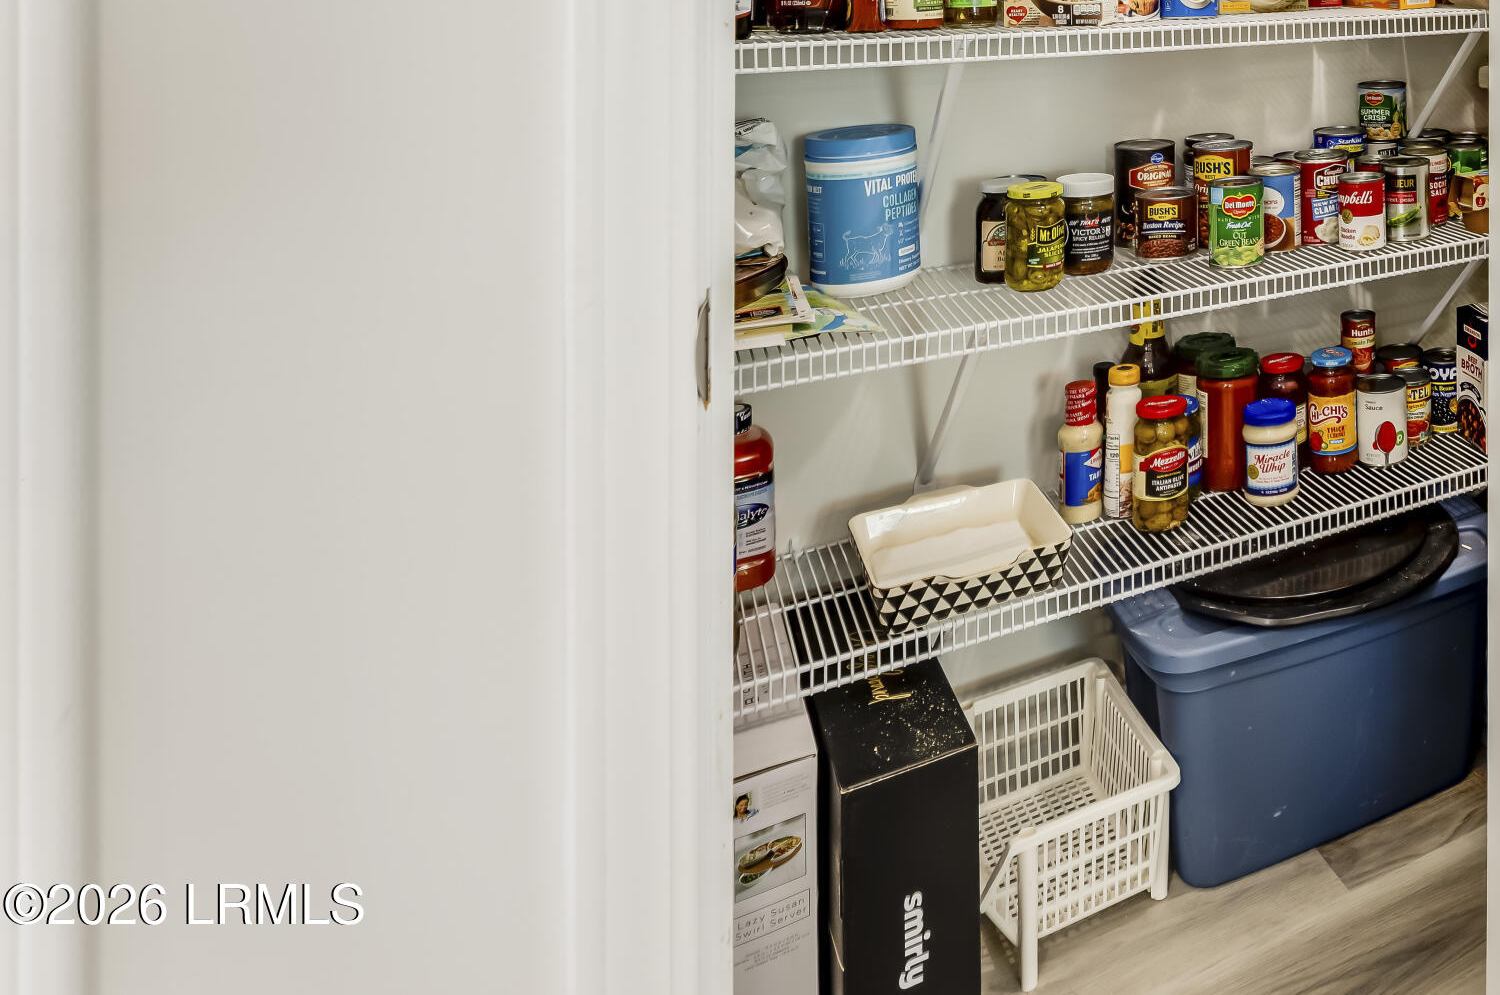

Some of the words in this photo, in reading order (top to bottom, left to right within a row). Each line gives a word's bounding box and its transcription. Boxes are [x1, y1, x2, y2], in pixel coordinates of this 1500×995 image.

[1057, 5, 1064, 13] 8
[1360, 108, 1391, 117] SUMMER
[1363, 114, 1387, 122] CRISP
[1337, 137, 1362, 145] StarKist
[1195, 161, 1231, 175] BUSH'S
[864, 176, 893, 197] VITAL
[1316, 175, 1339, 187] CHU
[1235, 200, 1255, 208] Monte
[1314, 204, 1335, 215] CLAM
[885, 200, 917, 221] PEPTIDES
[1149, 207, 1177, 216] BUSH'S
[1071, 225, 1106, 236] VICTOR'S
[1162, 221, 1184, 230] Recipe
[1039, 229, 1051, 242] Mt.
[1051, 225, 1065, 240] Oliv
[1232, 231, 1247, 239] CUT
[1219, 238, 1240, 247] GREEN
[1241, 237, 1259, 245] BEANS
[1351, 328, 1374, 337] Hunt's
[1467, 354, 1478, 364] BEEF
[1423, 366, 1457, 381] OYA
[1461, 358, 1483, 380] BROTH
[1364, 403, 1383, 411] Sauce
[1308, 402, 1349, 426] CHI-CHI'S
[1326, 425, 1346, 433] THICK
[1149, 450, 1186, 468] Mezzetta
[1253, 448, 1291, 466] Miracle
[1260, 462, 1286, 475] Whip
[1151, 478, 1172, 486] ITALIAN
[1172, 473, 1185, 483] OLIVE
[1155, 481, 1182, 492] ANTIPASTO
[736, 912, 766, 931] Lazy
[770, 897, 806, 918] Susan
[735, 922, 766, 942] Swirl
[769, 906, 808, 928] Server
[898, 891, 931, 990] smirly
